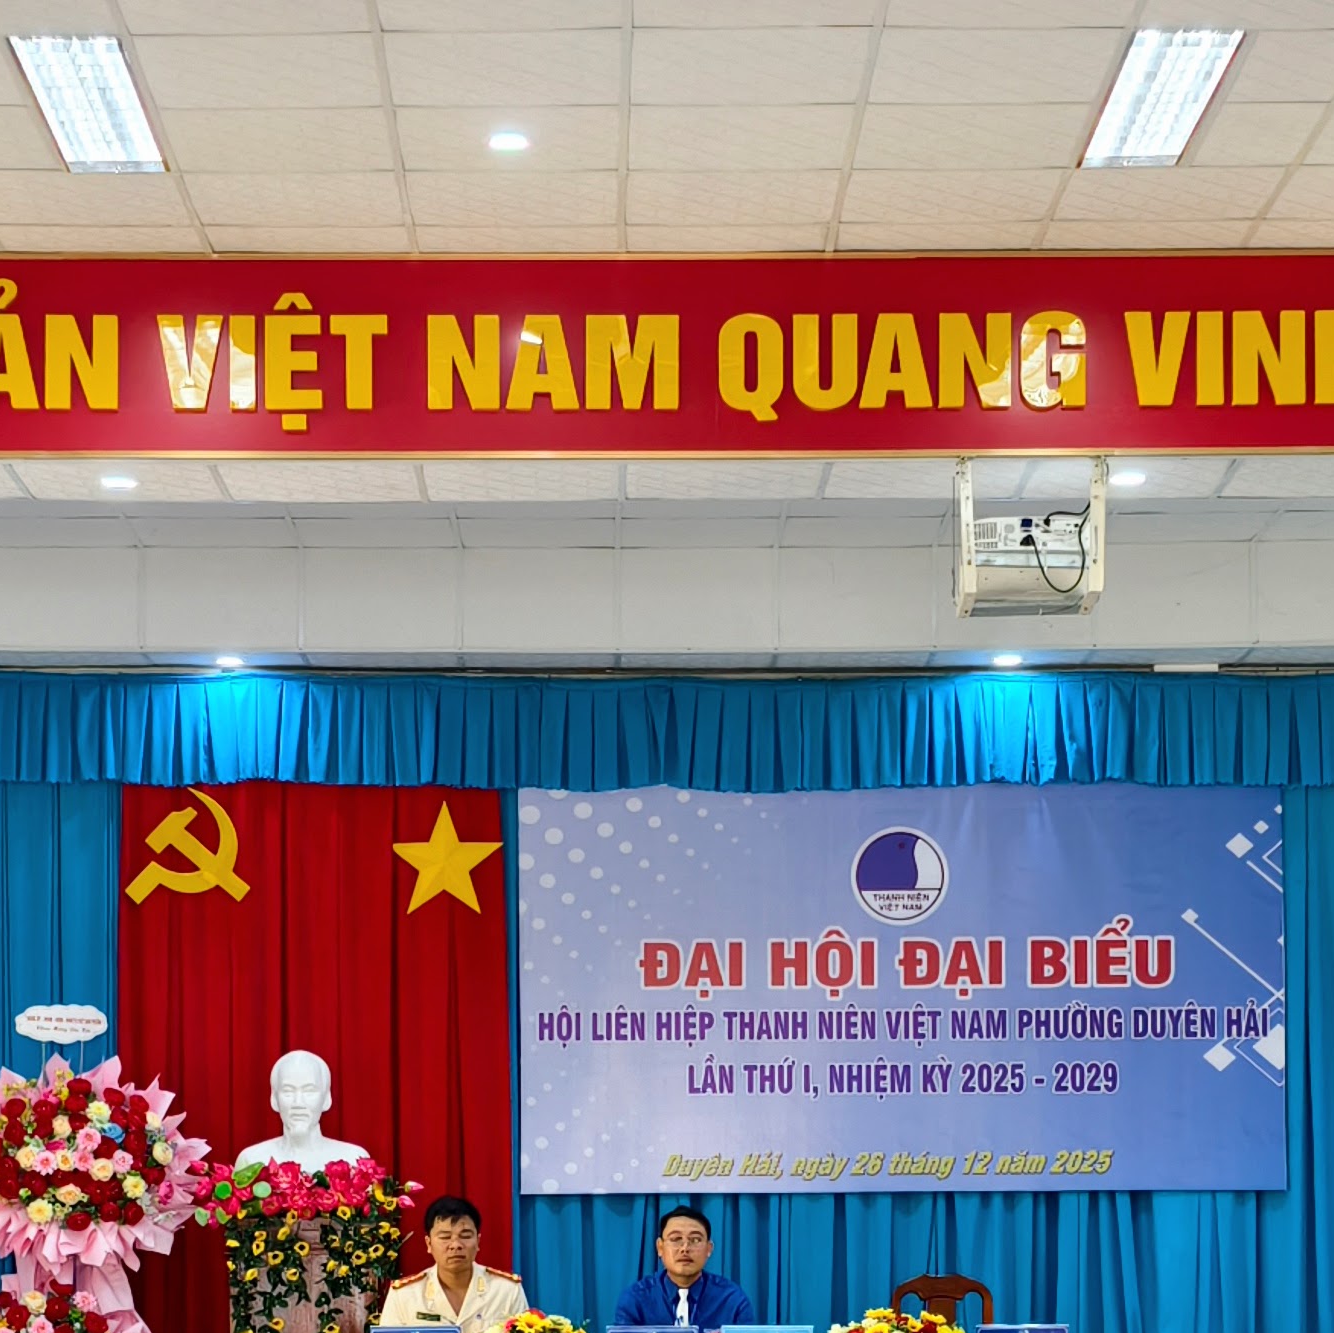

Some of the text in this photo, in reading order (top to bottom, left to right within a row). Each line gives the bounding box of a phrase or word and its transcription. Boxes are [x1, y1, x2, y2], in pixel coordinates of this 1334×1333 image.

[157, 293, 389, 430] VIỆT
[427, 314, 680, 412] NAM
[718, 311, 1088, 421] QUANG
[638, 915, 1172, 998] ĐẠI HỘI ĐẠI BIỂU
[538, 998, 1269, 1049] HỘI LIÊN HIỆP THANH NIÊN VIỆT NAM PHƯỜNG DUYÊN HẢI
[687, 1053, 1119, 1100] LẦN THỨ I, NHIỆM KỲ 2025 2029
[662, 1153, 734, 1181] Duyên
[790, 1151, 850, 1181] ngày
[888, 1150, 956, 1181] tháng
[963, 1150, 993, 1176] 12
[995, 1149, 1047, 1176] năm
[1050, 1149, 1115, 1175] 2025
